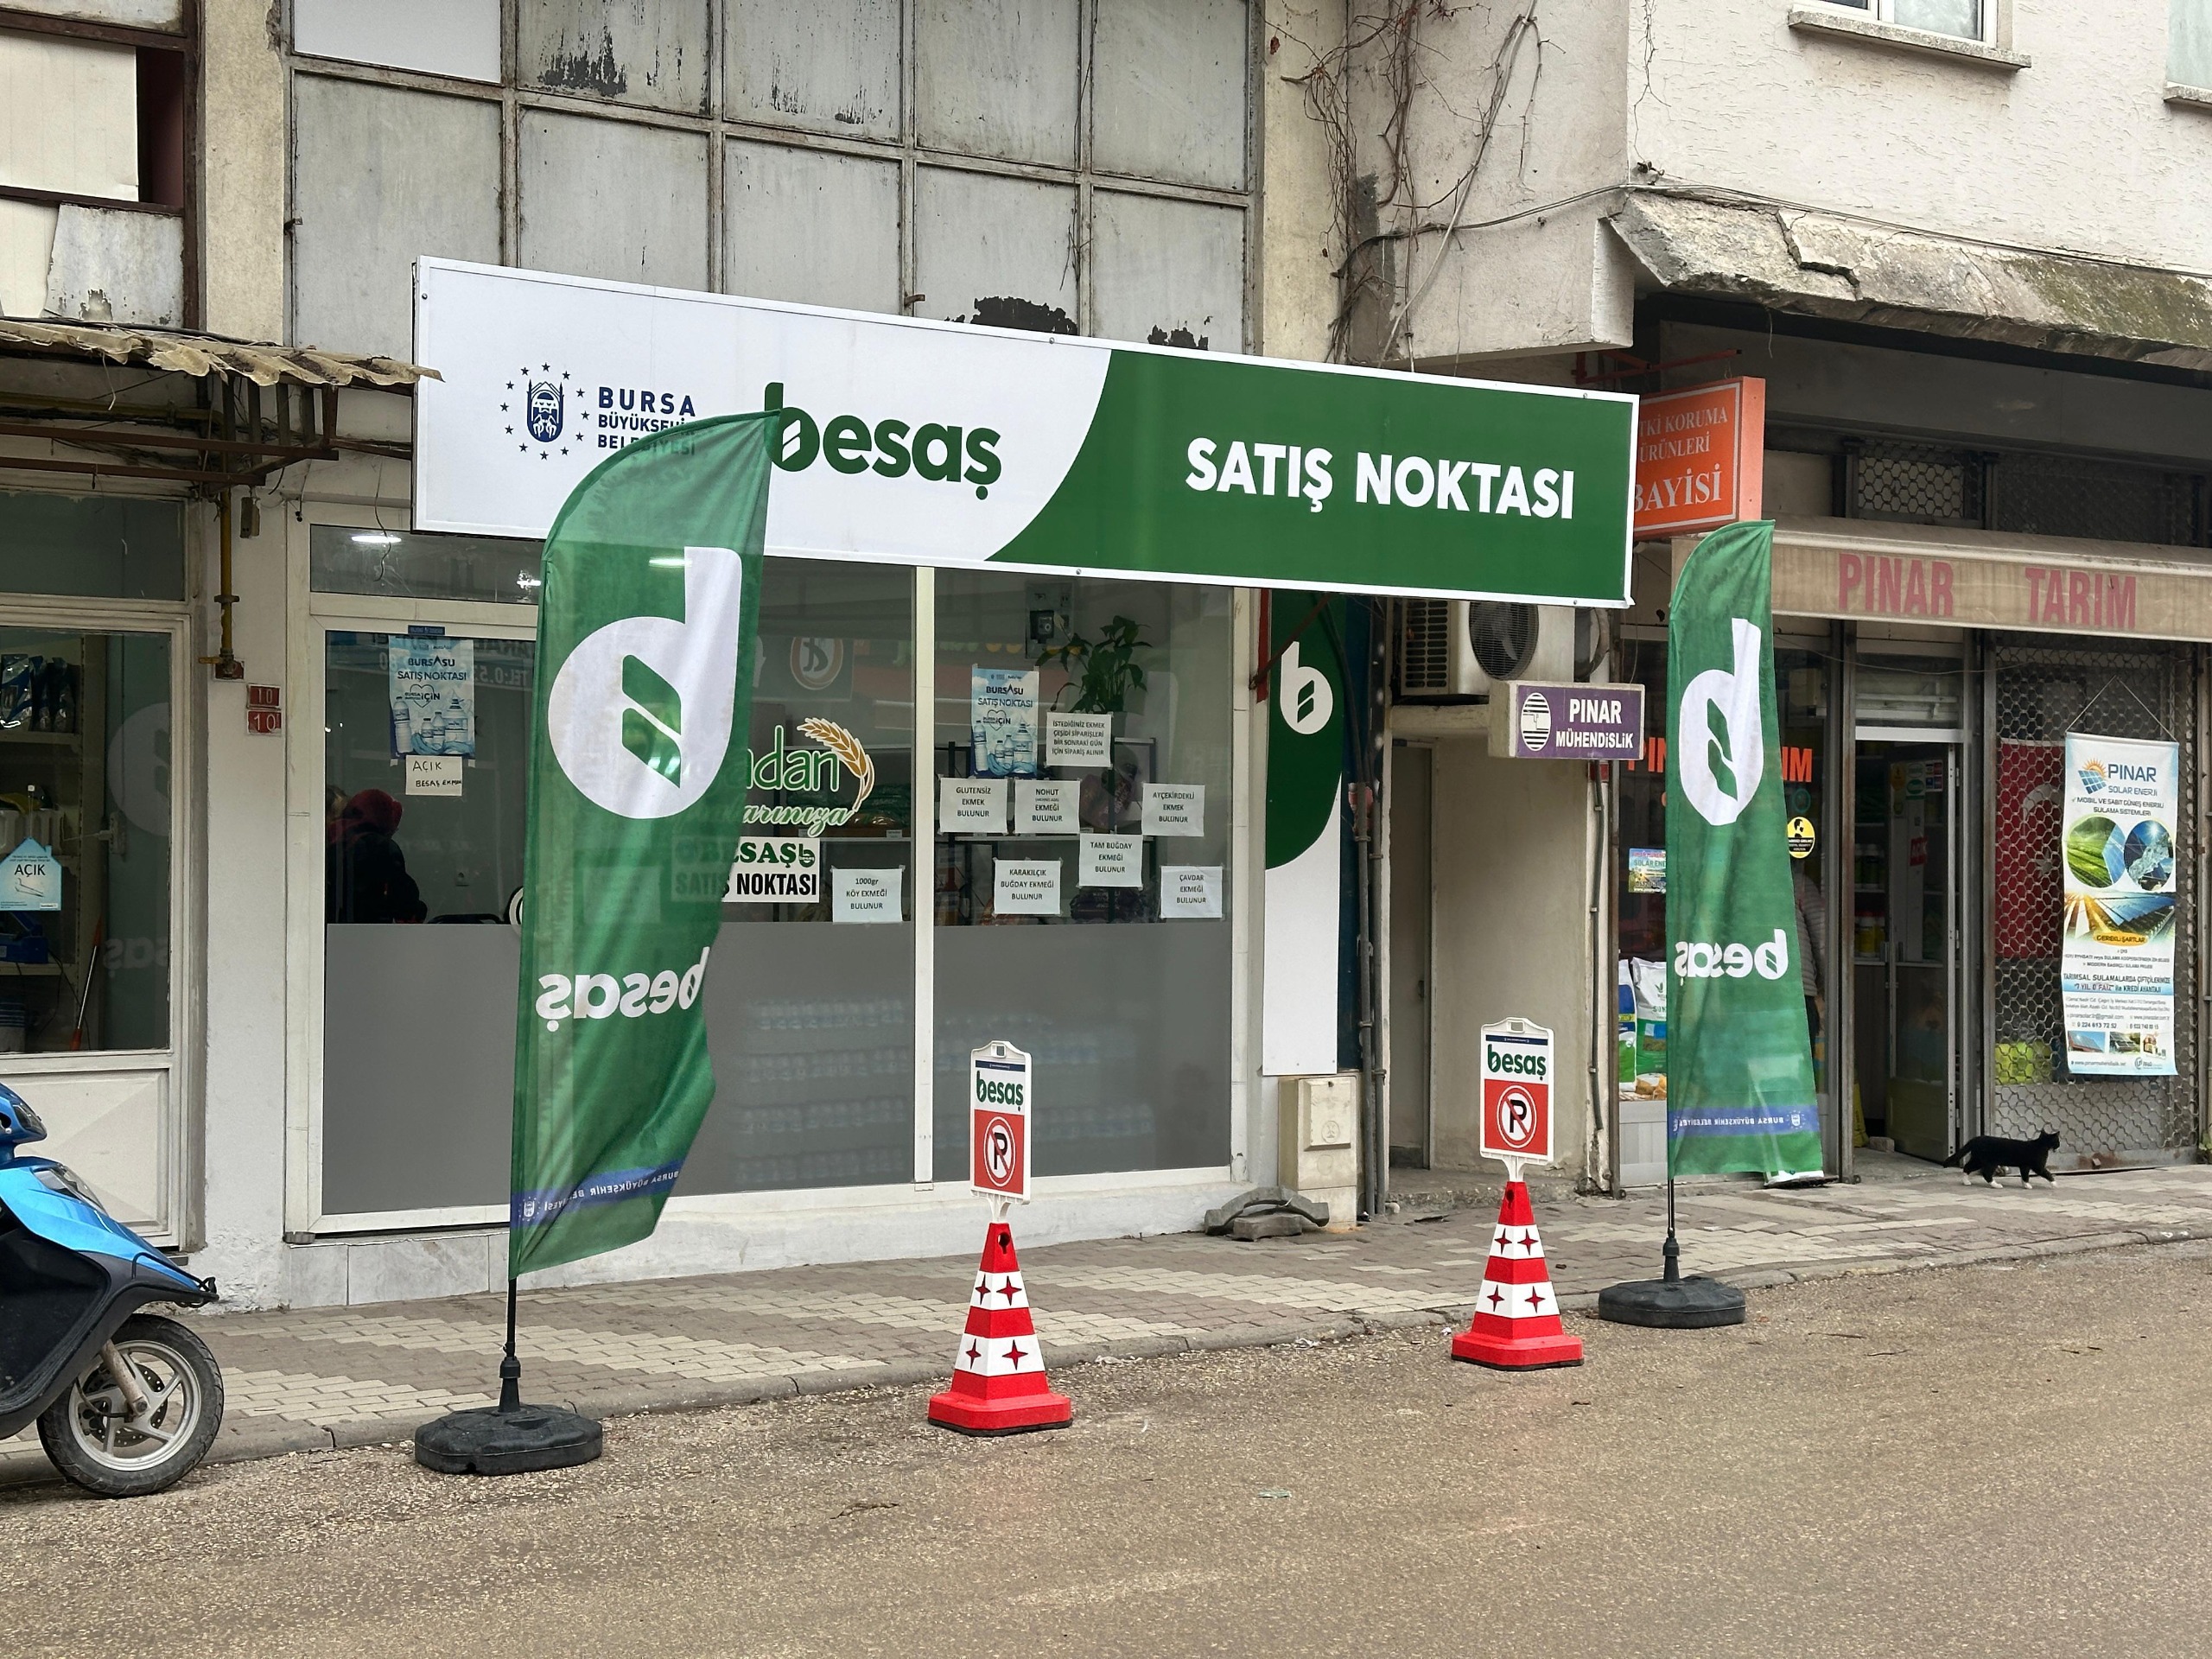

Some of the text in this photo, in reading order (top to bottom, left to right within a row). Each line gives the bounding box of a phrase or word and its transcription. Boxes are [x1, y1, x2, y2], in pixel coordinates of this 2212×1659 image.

[599, 387, 696, 416] BURSA
[1638, 406, 1728, 437] TKİ KORUMA
[765, 382, 1001, 499] besaş
[1639, 431, 1711, 463] ÜRÜNLERİ
[1185, 437, 1574, 519] SATIŞ NOKTASI
[1635, 463, 1723, 512] BAYİSİ
[1839, 553, 2136, 630] PINAR TARIM
[397, 671, 467, 683] SATIŞ NOKTASI
[258, 689, 273, 704] 10
[977, 697, 1033, 709] SATIŞ NOKTASI
[1569, 698, 1623, 724] PINAR
[254, 714, 276, 732] 10
[412, 760, 442, 773] AÇIK
[2107, 763, 2157, 783] PINAR
[956, 786, 991, 795] GLUTENSİZ
[2108, 785, 2133, 795] SOLAR
[957, 809, 989, 817] BULUNUR
[1035, 803, 1059, 811] EKMEĞİ
[1106, 841, 1133, 850] BUĞDAY
[1098, 853, 1123, 861] EKMEĞİ
[14, 864, 46, 877] AÇIK
[736, 873, 817, 896] NOKTASI
[1000, 880, 1054, 888] BUĞDAY EKMEĞİ
[1179, 874, 1205, 883] ÇAVDAR
[861, 888, 887, 897] EKMEĞİ
[1179, 884, 1204, 893] EKMEĞİ
[1487, 1044, 1547, 1081] besaş
[976, 1070, 1024, 1112] besaş
